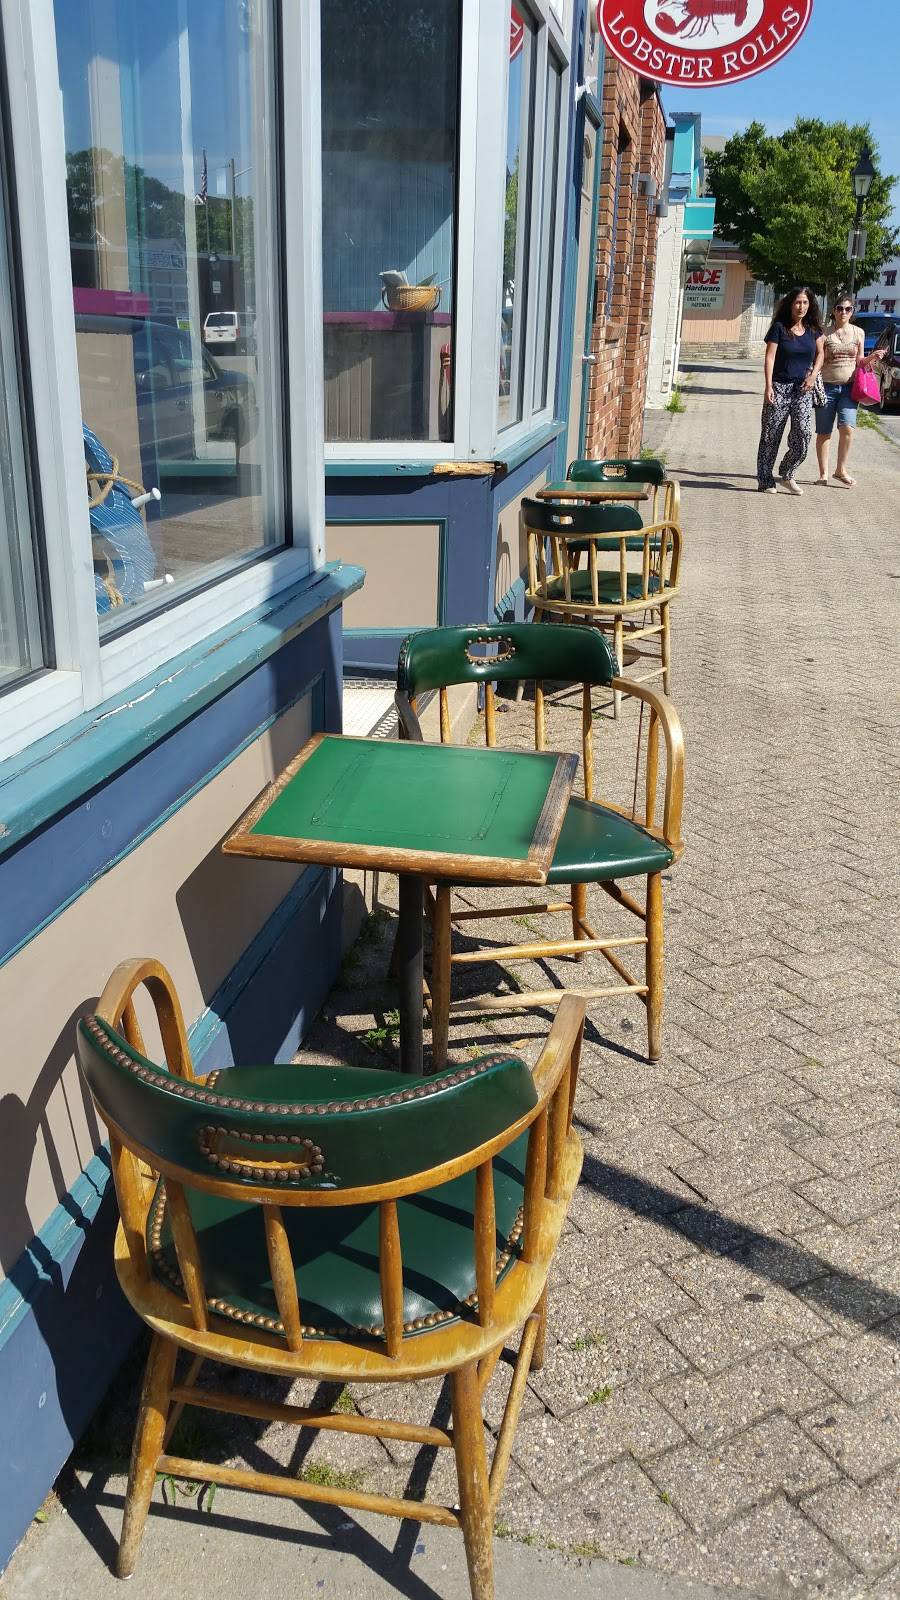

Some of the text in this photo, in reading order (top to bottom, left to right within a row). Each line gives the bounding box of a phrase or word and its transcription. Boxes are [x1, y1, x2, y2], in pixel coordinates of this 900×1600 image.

[608, 6, 801, 79] LOBSTER ROLLS
[686, 269, 722, 284] ACE
[686, 284, 720, 292] Hardware
